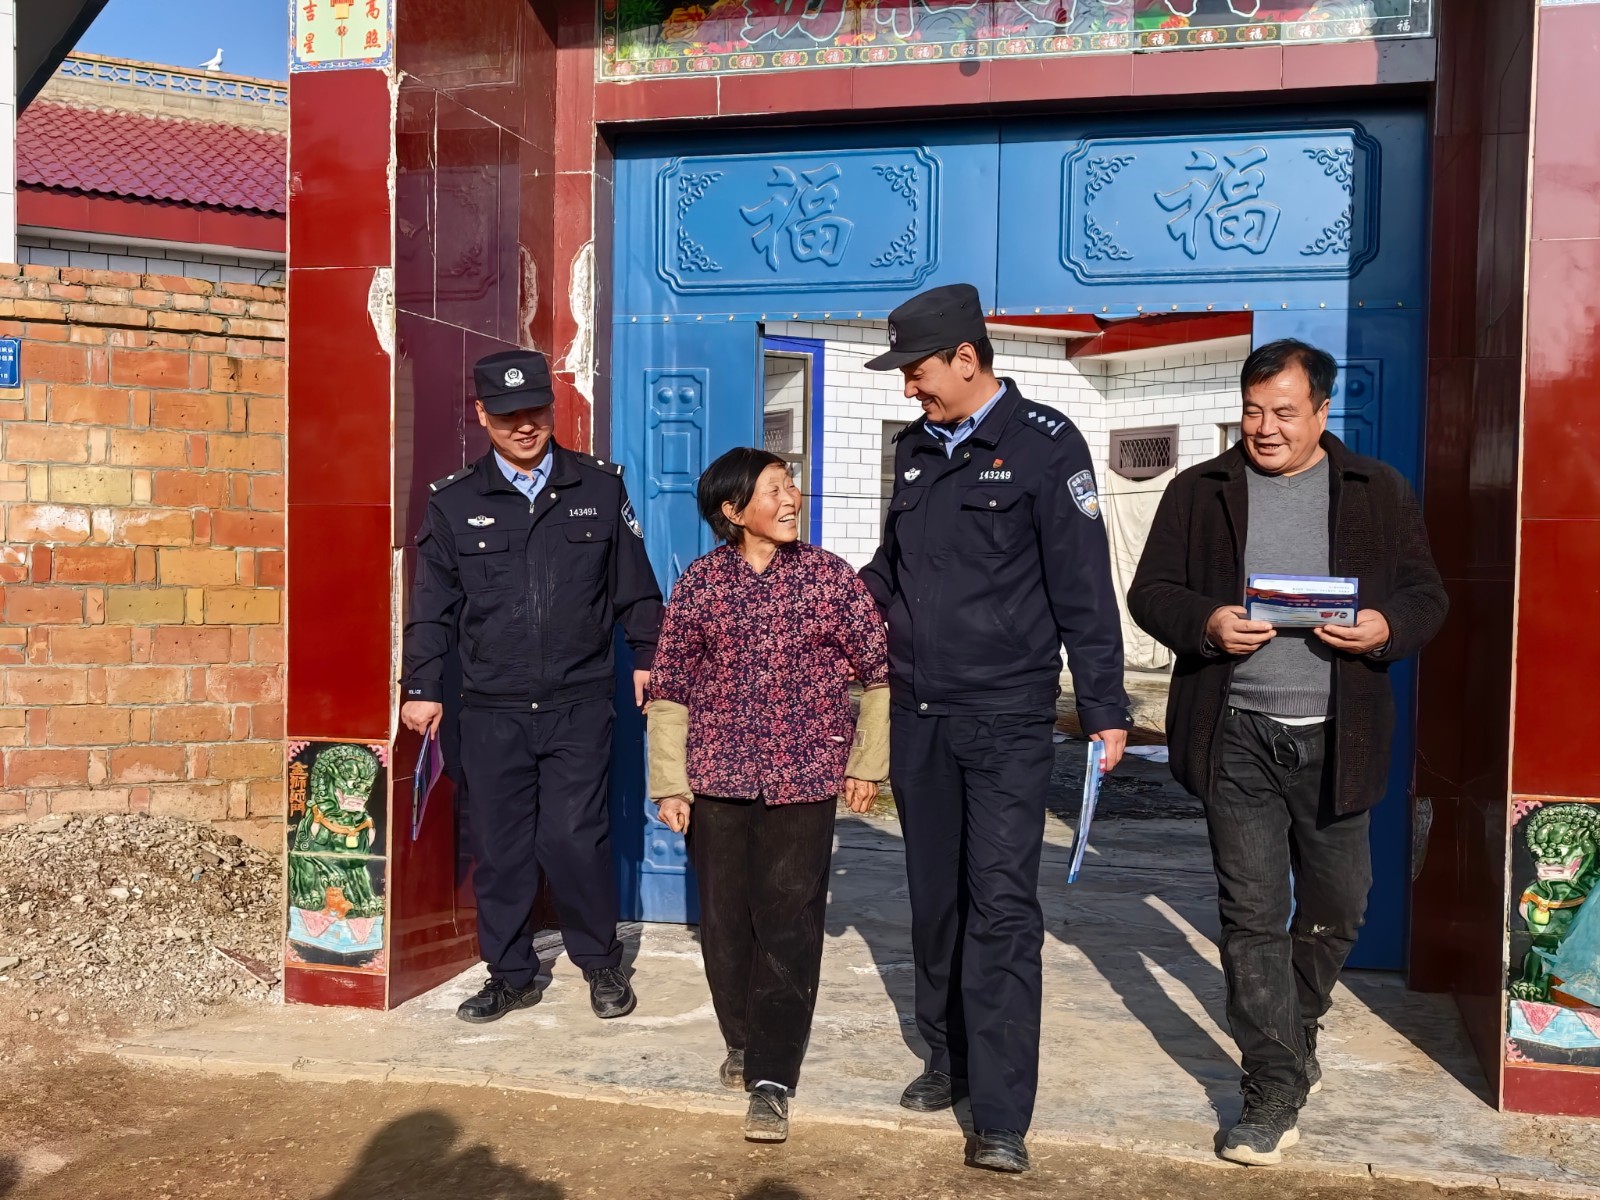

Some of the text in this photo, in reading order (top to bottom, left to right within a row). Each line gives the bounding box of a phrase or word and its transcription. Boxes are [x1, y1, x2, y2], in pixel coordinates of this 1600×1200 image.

[303, 0, 318, 53] 吉星
[363, 0, 381, 50] 高照
[827, 51, 840, 62] 福
[917, 47, 930, 58] 福
[1056, 38, 1069, 49] 福
[1103, 34, 1118, 47] 福
[1151, 34, 1165, 45] 福
[1200, 31, 1213, 43] 福
[1249, 28, 1263, 40] 福
[1298, 26, 1312, 38] 福
[1347, 22, 1361, 34] 福
[1396, 20, 1411, 31] 福
[739, 162, 854, 272] 福
[1153, 145, 1281, 260] 福
[979, 470, 1012, 480] 143249
[569, 507, 598, 517] 143491
